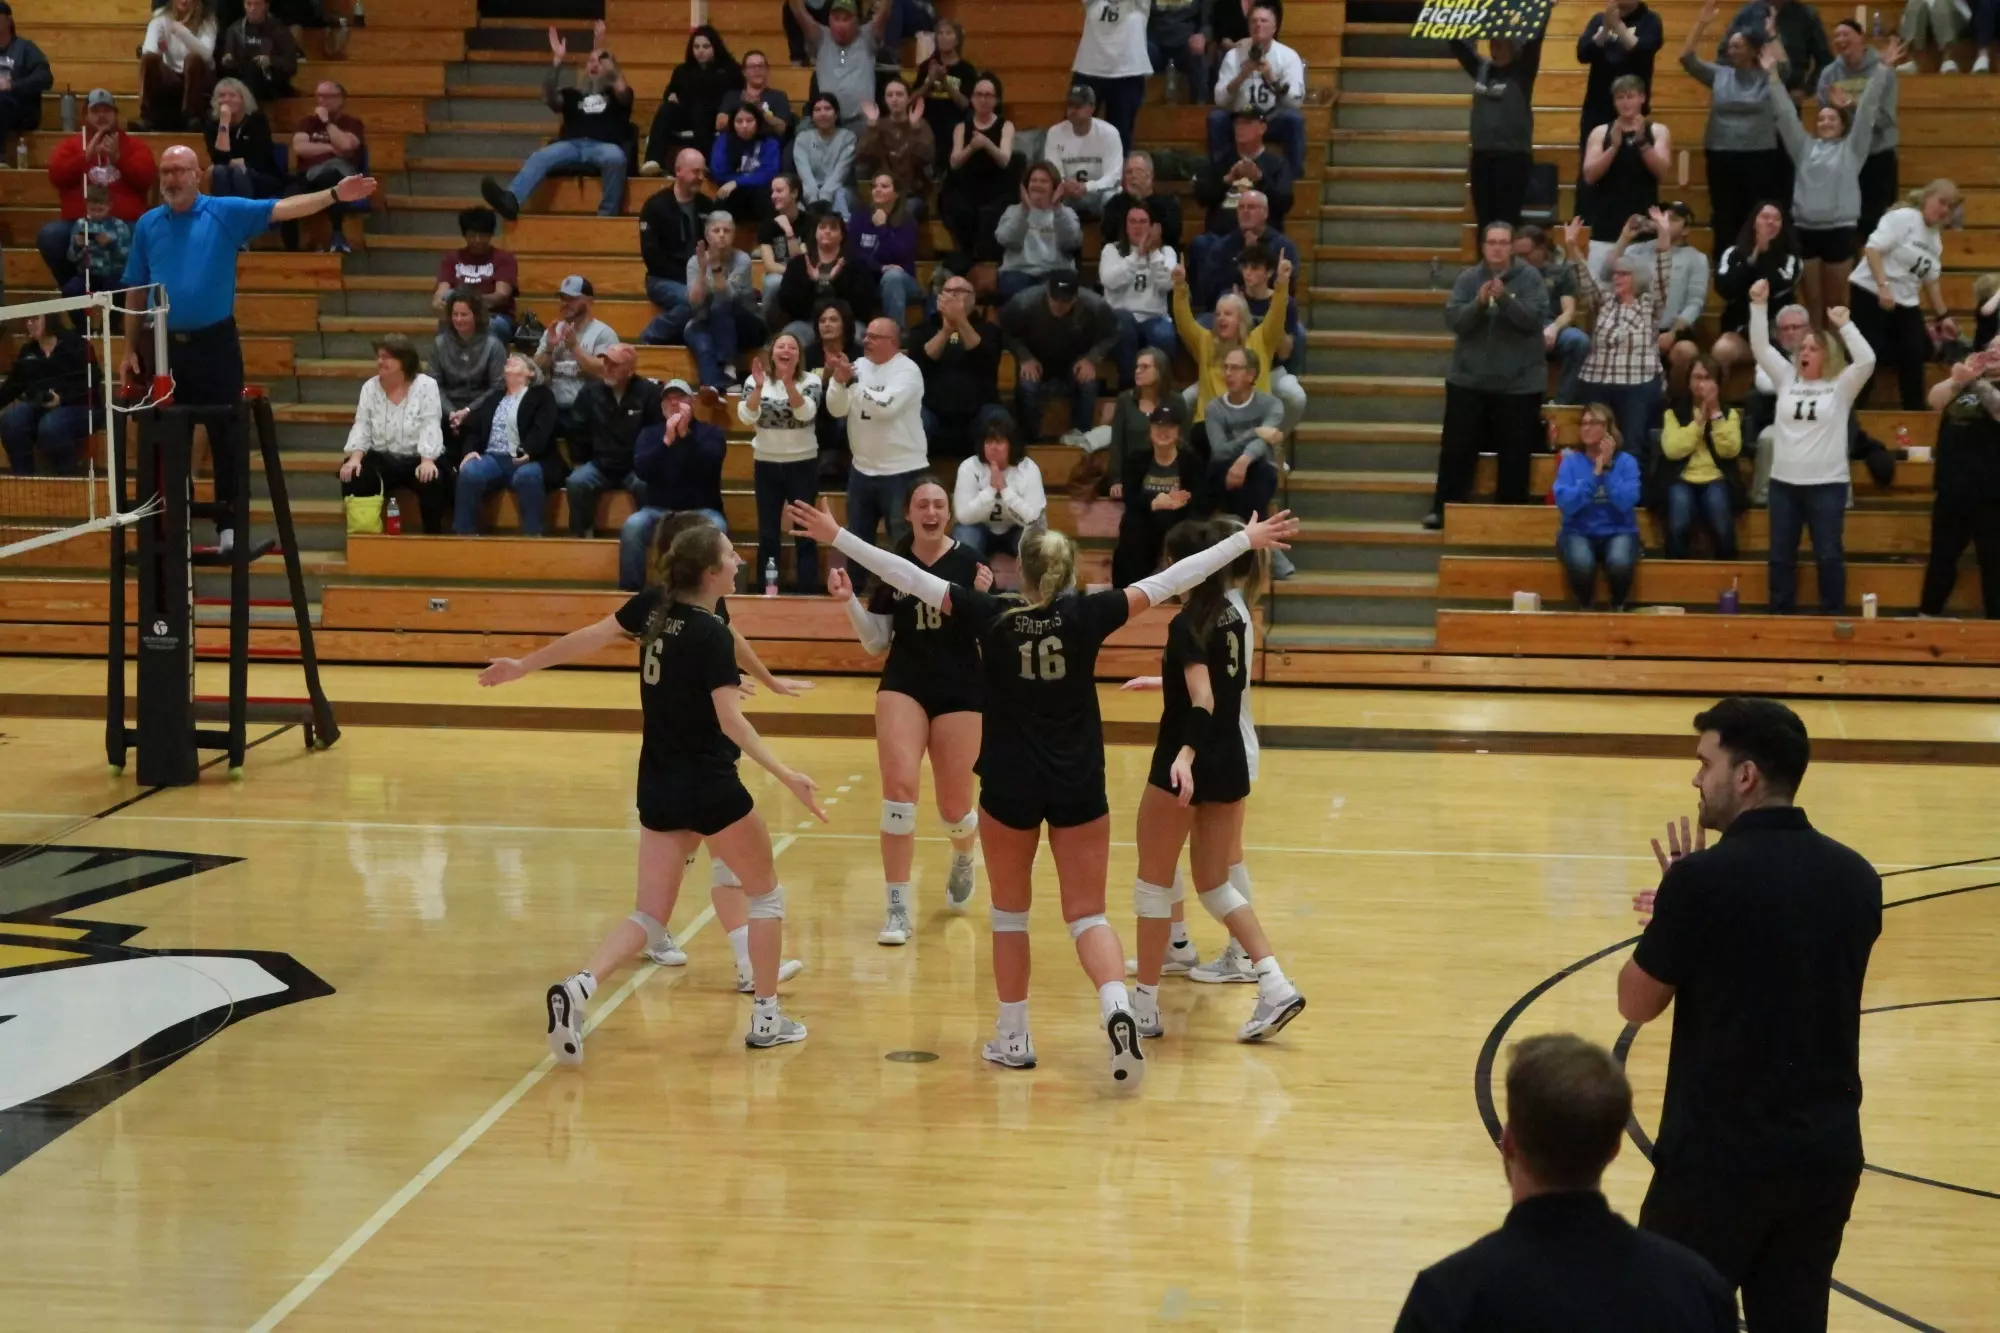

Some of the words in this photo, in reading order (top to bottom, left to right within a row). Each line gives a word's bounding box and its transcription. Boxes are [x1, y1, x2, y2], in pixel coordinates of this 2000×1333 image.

[1417, 8, 1488, 25] FIGHT!
[1410, 22, 1482, 40] FIGHT!
[1249, 84, 1270, 104] 16
[1793, 399, 1818, 421] 11
[989, 503, 1003, 522] 2
[914, 601, 942, 630] 18
[643, 638, 664, 686] 6
[1018, 635, 1067, 681] 16
[1226, 630, 1240, 678] 3
